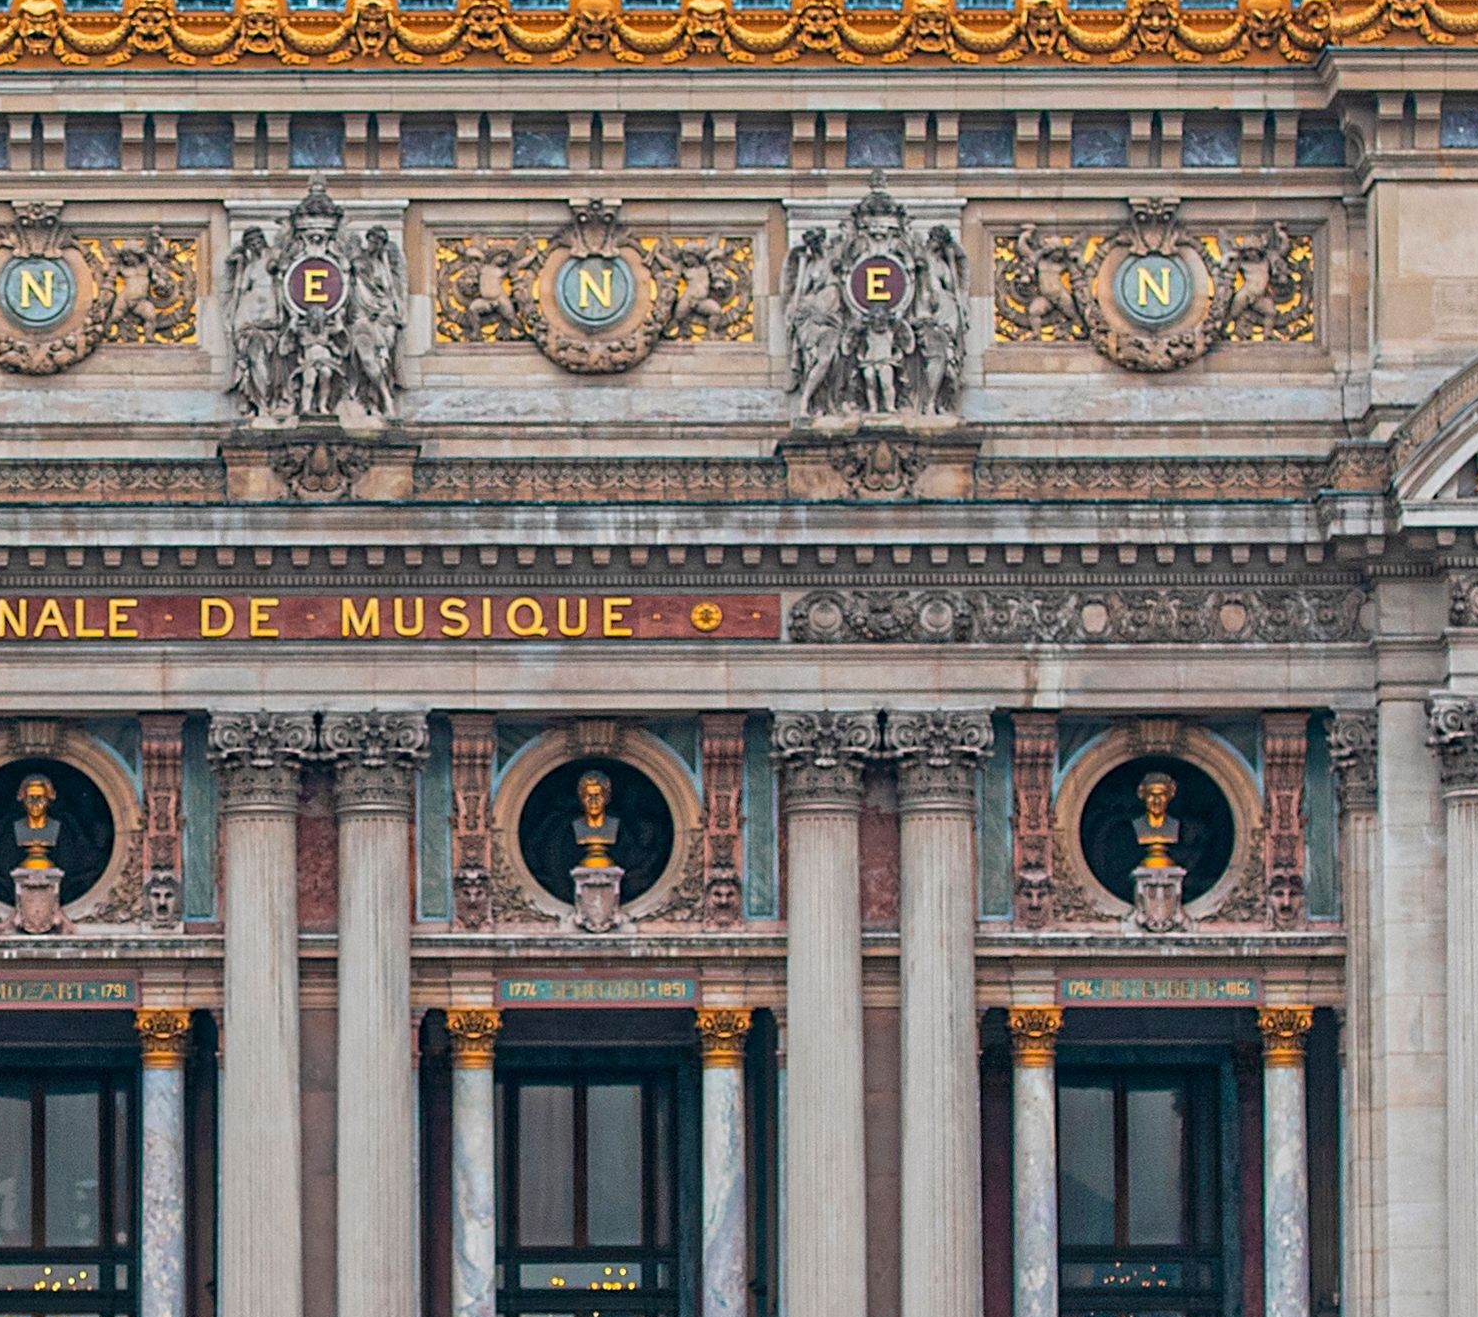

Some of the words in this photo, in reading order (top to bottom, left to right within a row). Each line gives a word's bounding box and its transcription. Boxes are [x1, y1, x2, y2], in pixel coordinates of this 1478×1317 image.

[22, 272, 53, 308] N
[304, 269, 329, 303] E
[580, 271, 612, 308] N
[866, 267, 891, 302] E
[1138, 269, 1170, 306] N
[199, 597, 280, 637] DE
[340, 597, 633, 637] MUSIQUE
